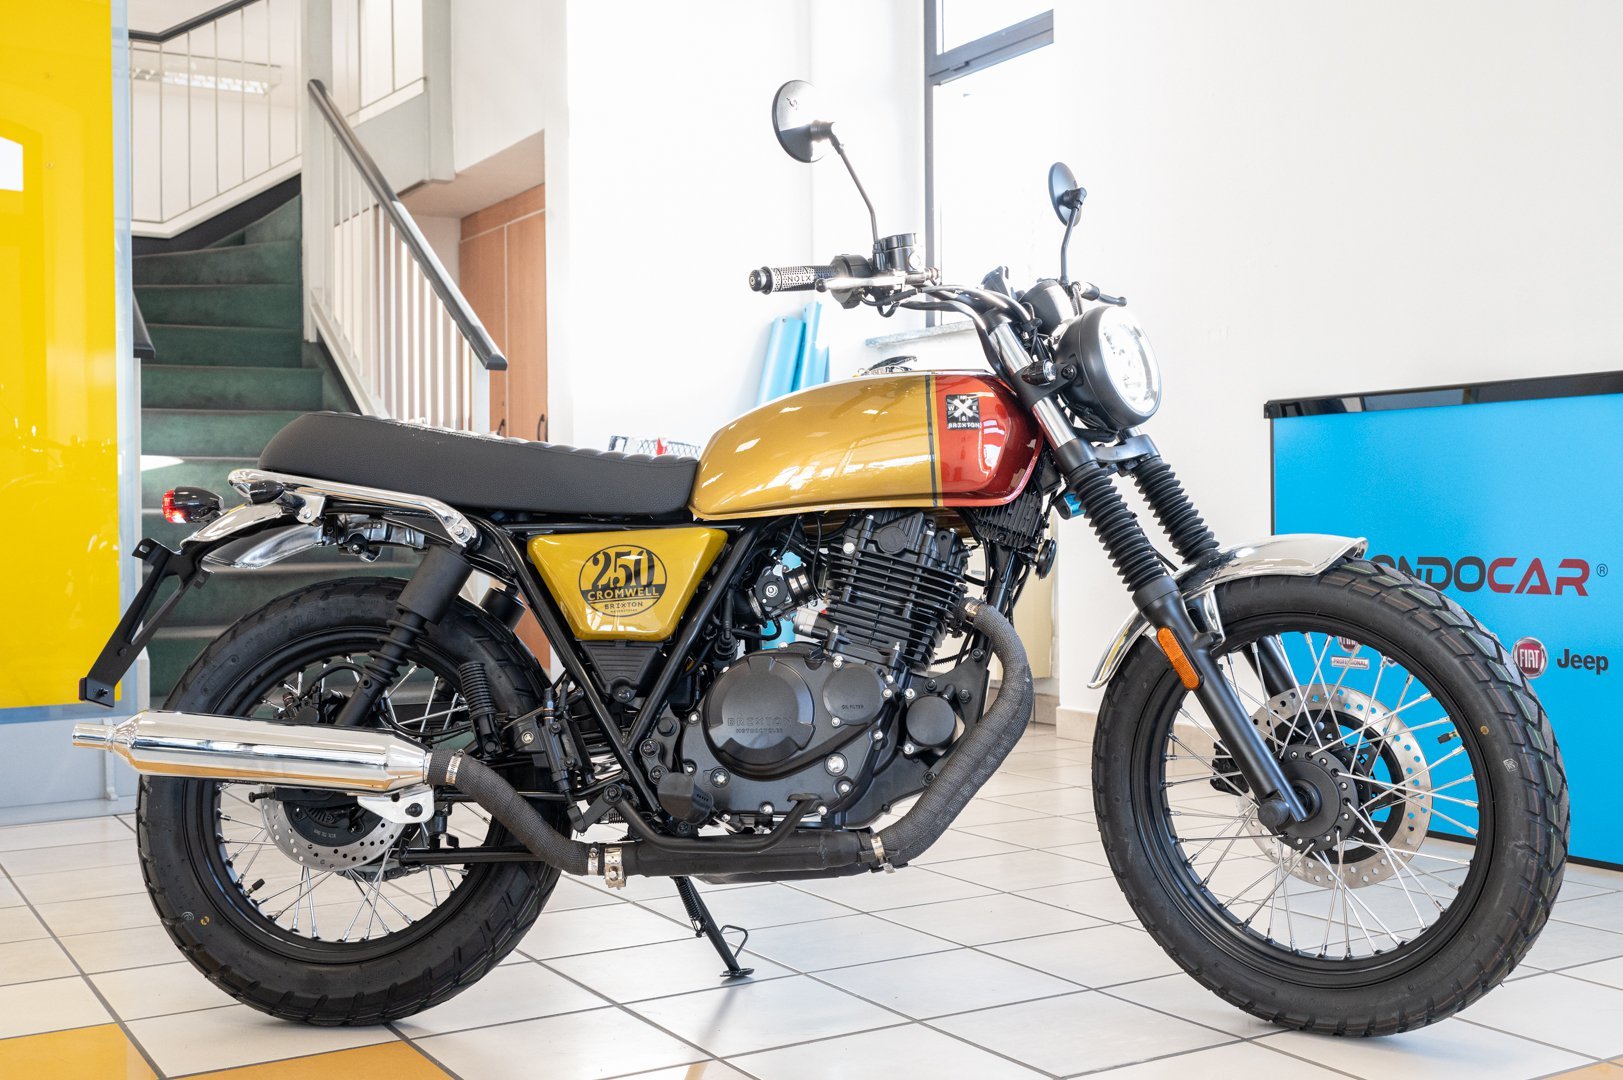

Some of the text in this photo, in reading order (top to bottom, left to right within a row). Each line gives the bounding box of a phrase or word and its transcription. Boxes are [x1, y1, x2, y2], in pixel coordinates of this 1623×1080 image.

[592, 549, 655, 590] 250
[587, 586, 659, 601] CROMWELL
[604, 601, 644, 610] BRIXTON
[1519, 649, 1540, 669] FIAT
[1557, 648, 1609, 675] Jeep
